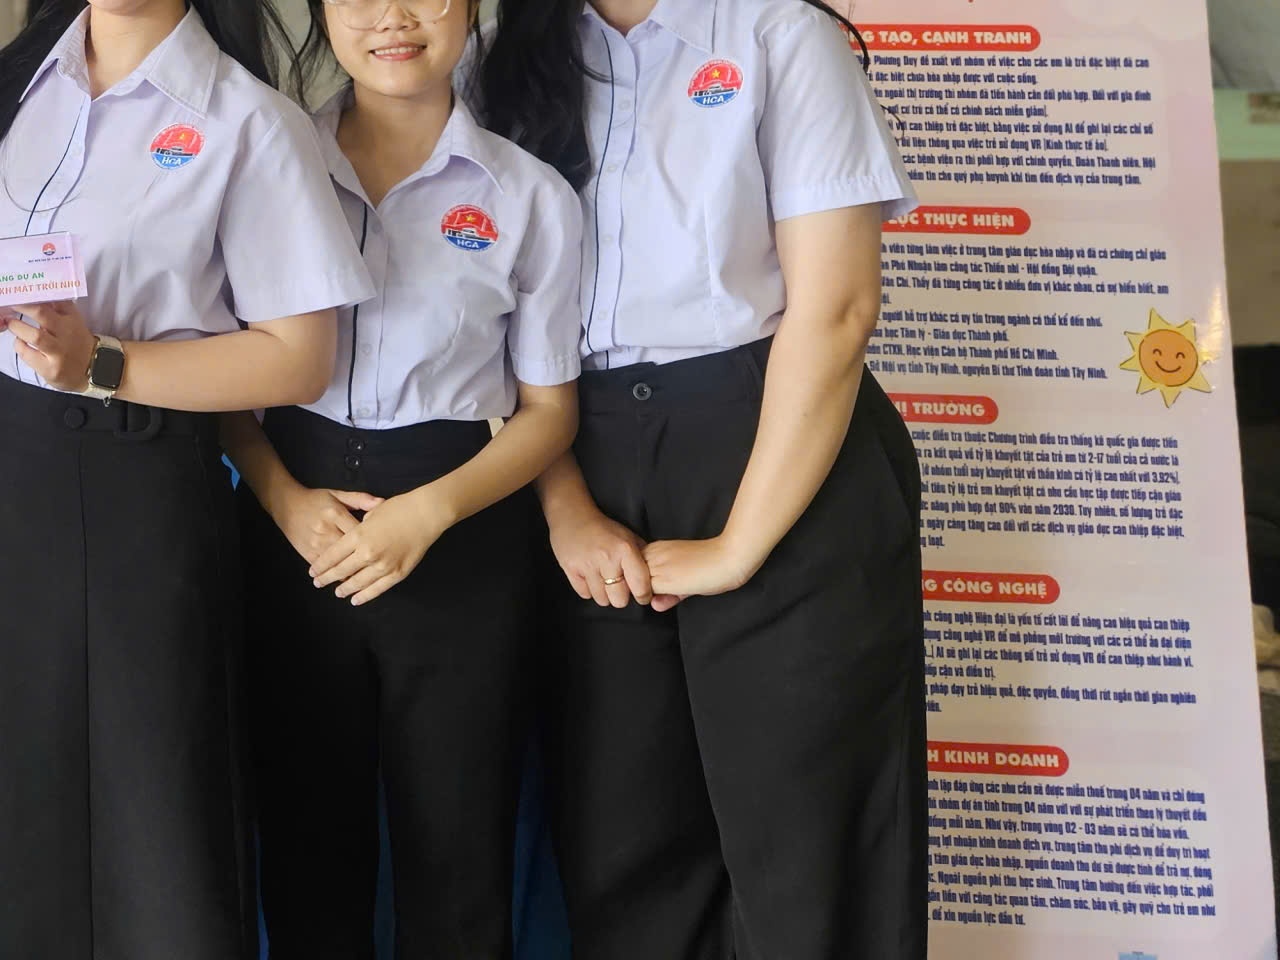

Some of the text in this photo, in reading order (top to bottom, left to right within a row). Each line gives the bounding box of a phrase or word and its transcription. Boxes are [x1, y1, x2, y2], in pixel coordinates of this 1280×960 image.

[879, 31, 919, 46] TẠO,
[922, 31, 968, 46] CẠNH
[973, 32, 1032, 44] TRANH
[903, 55, 918, 68] Duy
[999, 55, 1015, 69] việc
[1018, 56, 1032, 67] cho
[1034, 56, 1048, 67] các
[1051, 58, 1062, 67] em
[1089, 56, 1103, 70] đặc
[1106, 56, 1121, 70] biệt
[1135, 58, 1149, 67] can
[702, 95, 724, 105] HCA
[162, 156, 182, 165] HCA
[923, 213, 968, 228] THỰC
[973, 212, 1014, 229] HIỆN
[457, 239, 479, 248] HCA
[912, 400, 985, 417] TRƯỜNG
[943, 578, 993, 594] CÔNG
[999, 580, 1047, 598] NGHỆ
[945, 750, 989, 765] KINH
[995, 752, 1059, 768] DOANH
